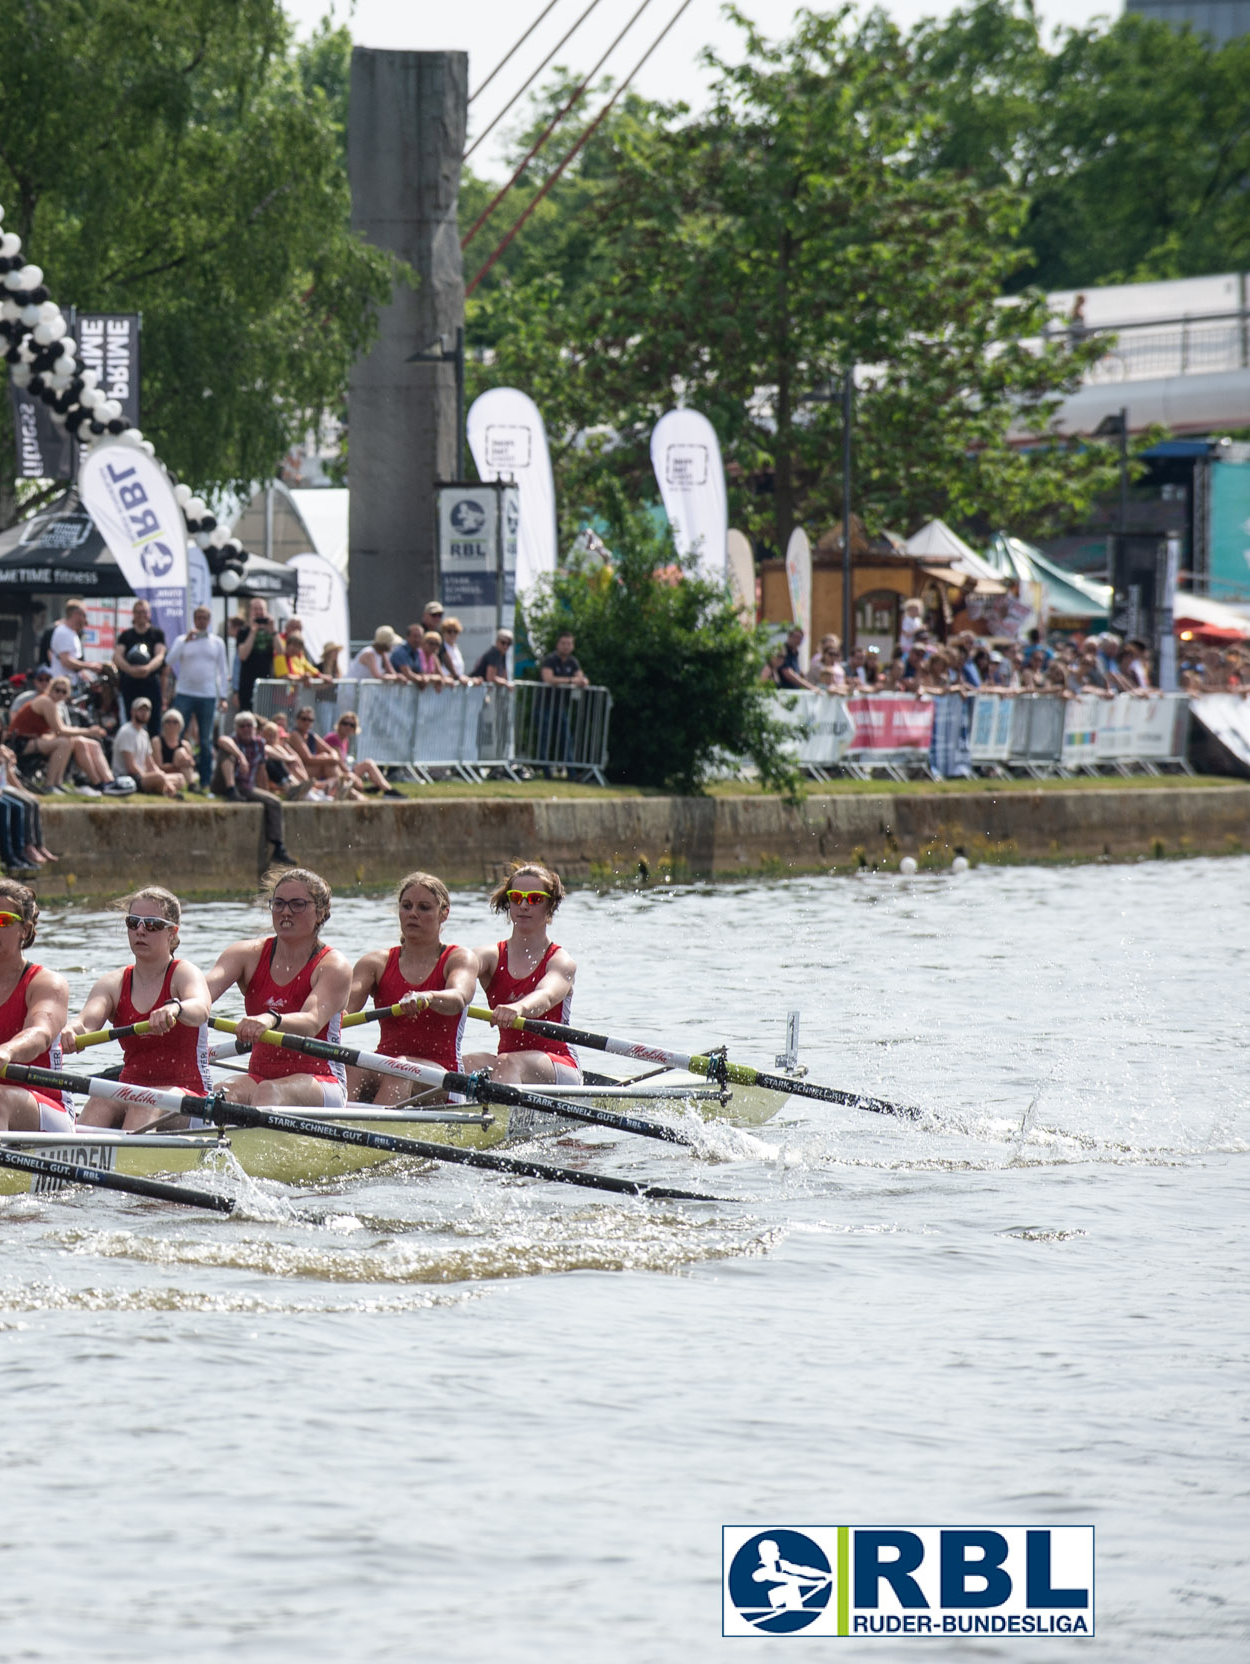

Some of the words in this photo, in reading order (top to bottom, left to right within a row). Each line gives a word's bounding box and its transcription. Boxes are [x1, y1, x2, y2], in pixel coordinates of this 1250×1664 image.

[450, 543, 486, 556] RBL
[54, 571, 98, 584] fitness
[628, 1044, 669, 1064] Melitta
[380, 1057, 423, 1077] Melitta
[111, 1086, 157, 1106] Melitta
[527, 1095, 555, 1108] STARK.
[556, 1102, 595, 1118] SCHNELL.
[596, 1112, 616, 1123] GUT.
[268, 1115, 298, 1129] STARK.
[300, 1121, 340, 1138] SCHNELL.
[342, 1131, 363, 1142] GUT.
[374, 1136, 391, 1146] RBL
[5, 1154, 48, 1171] SCHNELL.
[49, 1163, 71, 1176] GUT.
[82, 1170, 101, 1181] RBL
